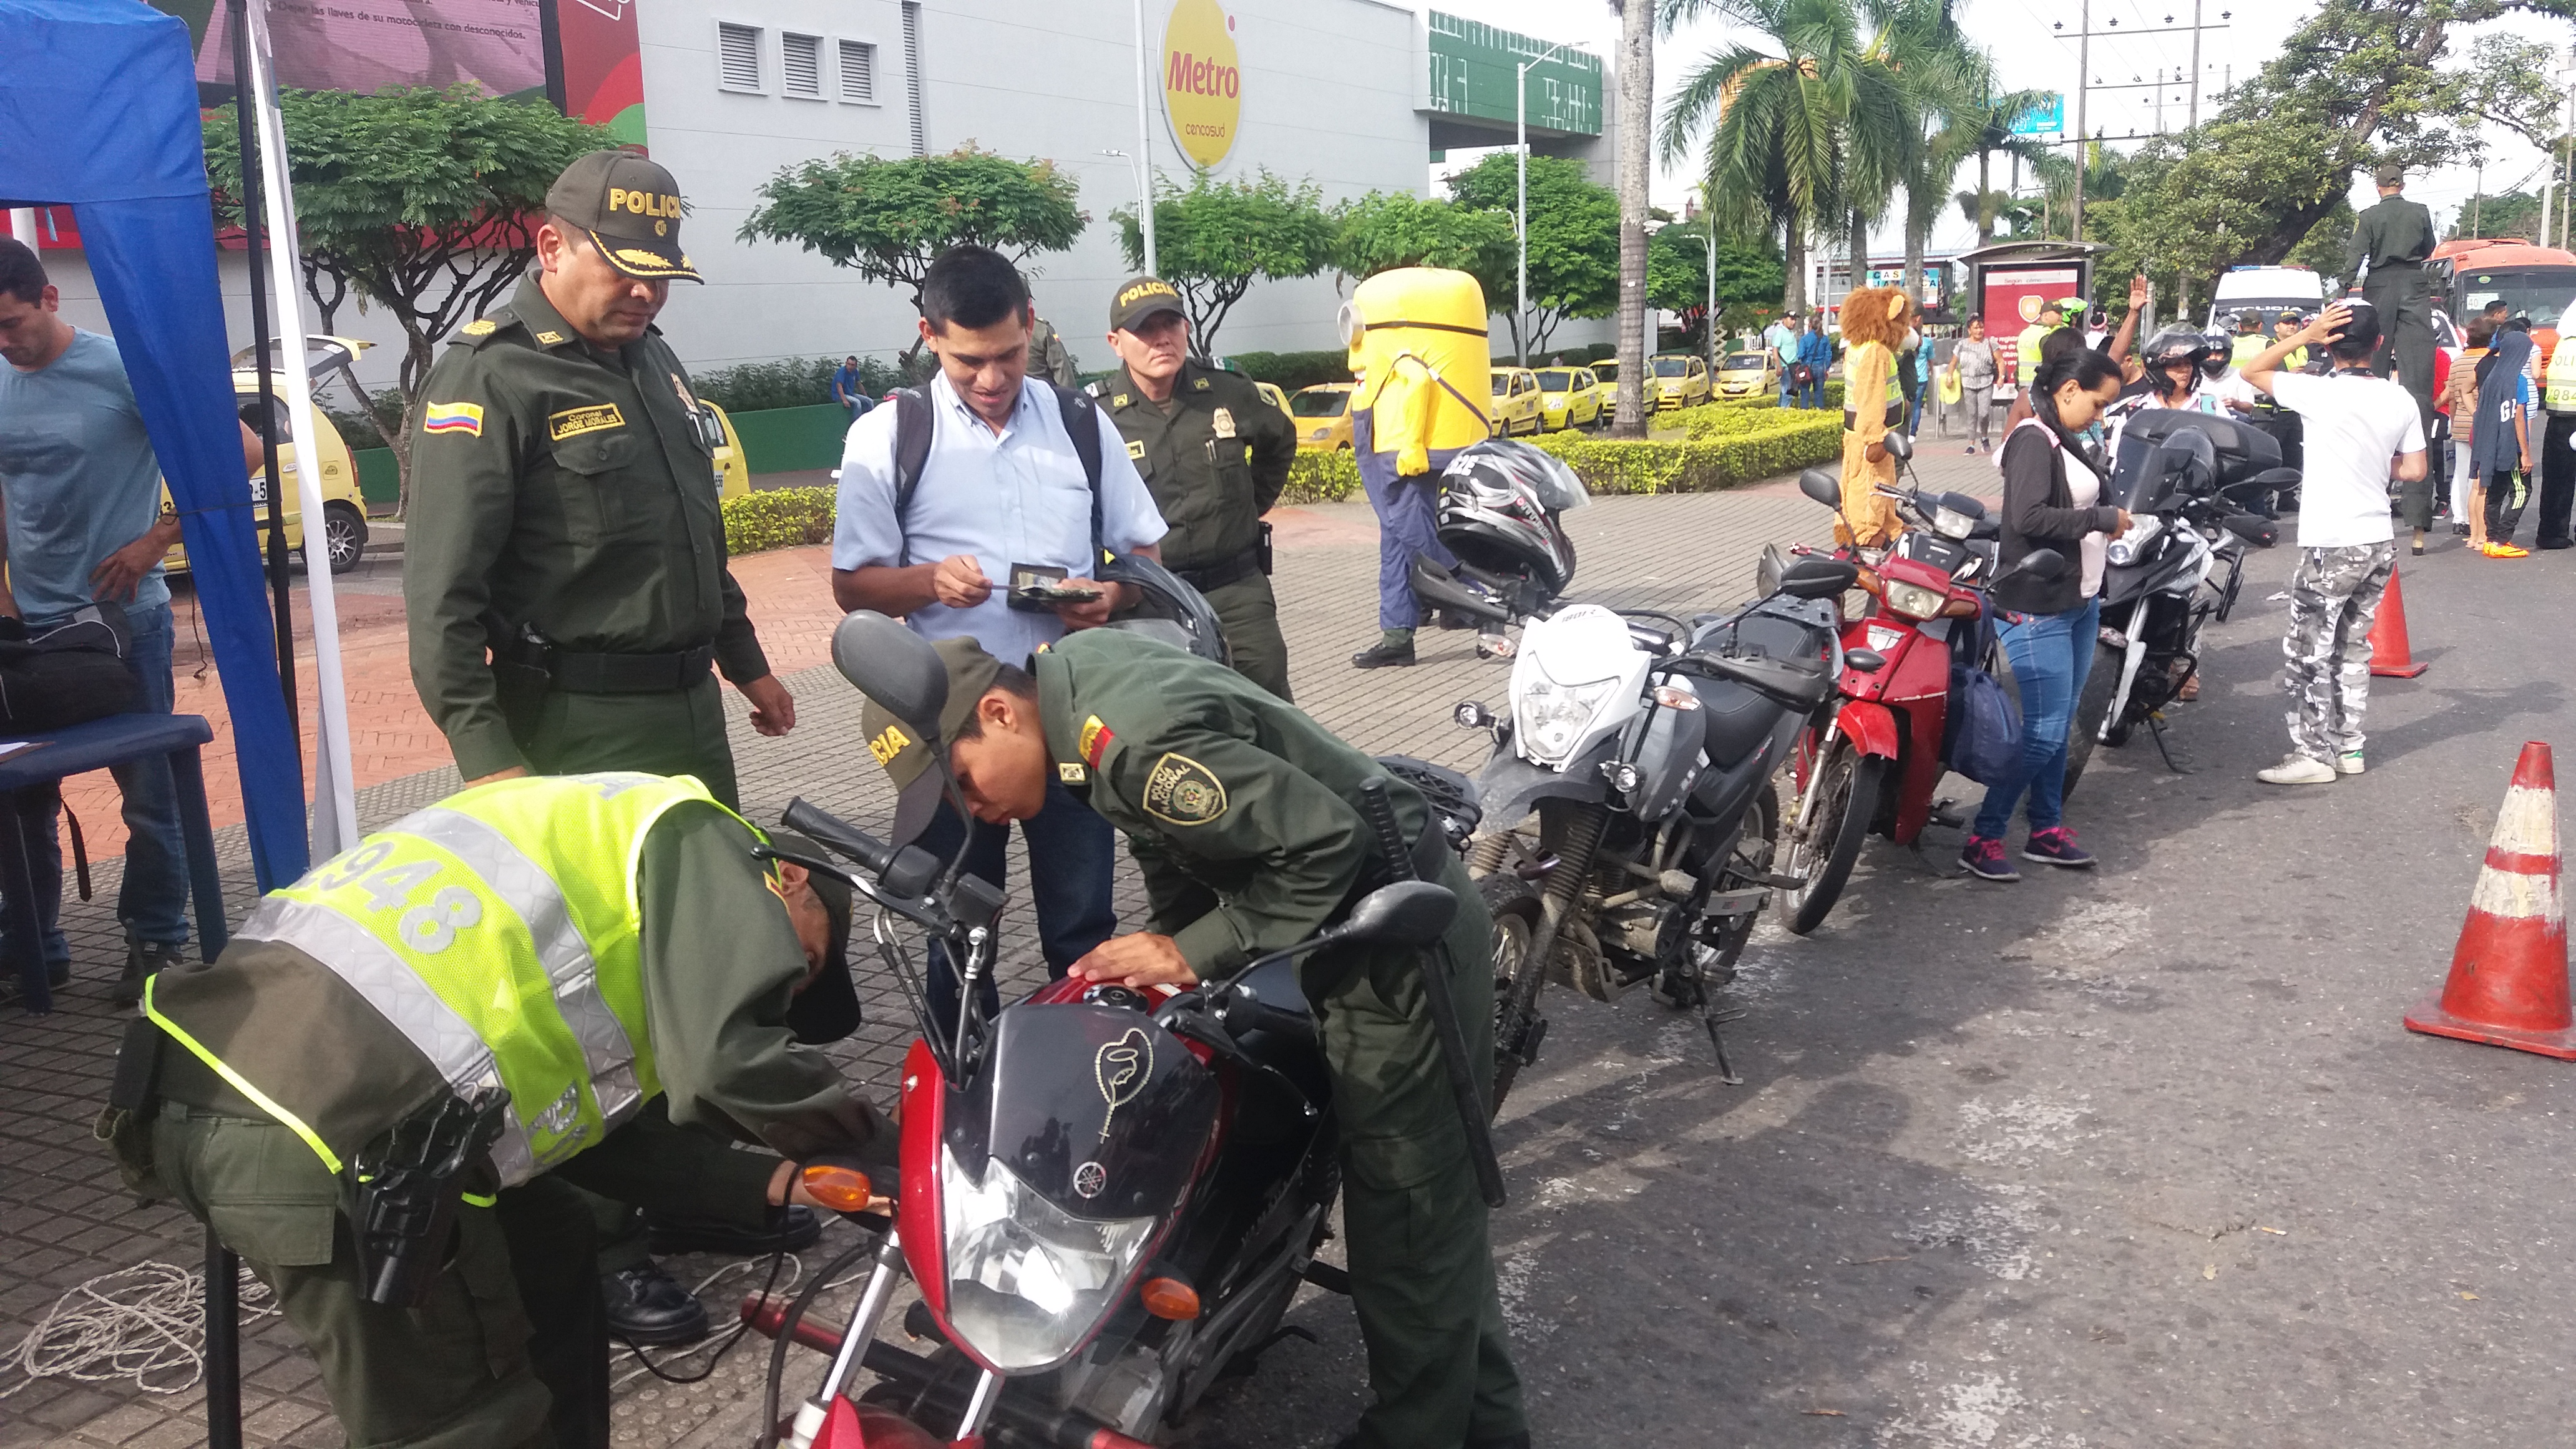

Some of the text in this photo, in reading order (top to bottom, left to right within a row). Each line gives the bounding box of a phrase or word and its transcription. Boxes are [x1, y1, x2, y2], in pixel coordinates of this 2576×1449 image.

[313, 7, 324, 16] las
[328, 7, 354, 19] llaves
[358, 11, 369, 21] de
[373, 14, 384, 22] su
[387, 17, 442, 29] motocicleta
[445, 23, 462, 32] con
[464, 24, 525, 39] desconocidos.
[1168, 51, 1239, 99] Metro
[1186, 123, 1225, 138] cencosud
[1120, 282, 1178, 308] POLICIA
[2468, 298, 2478, 307] 40
[557, 414, 618, 434] JORGE MORALES
[568, 410, 602, 422] Coronel
